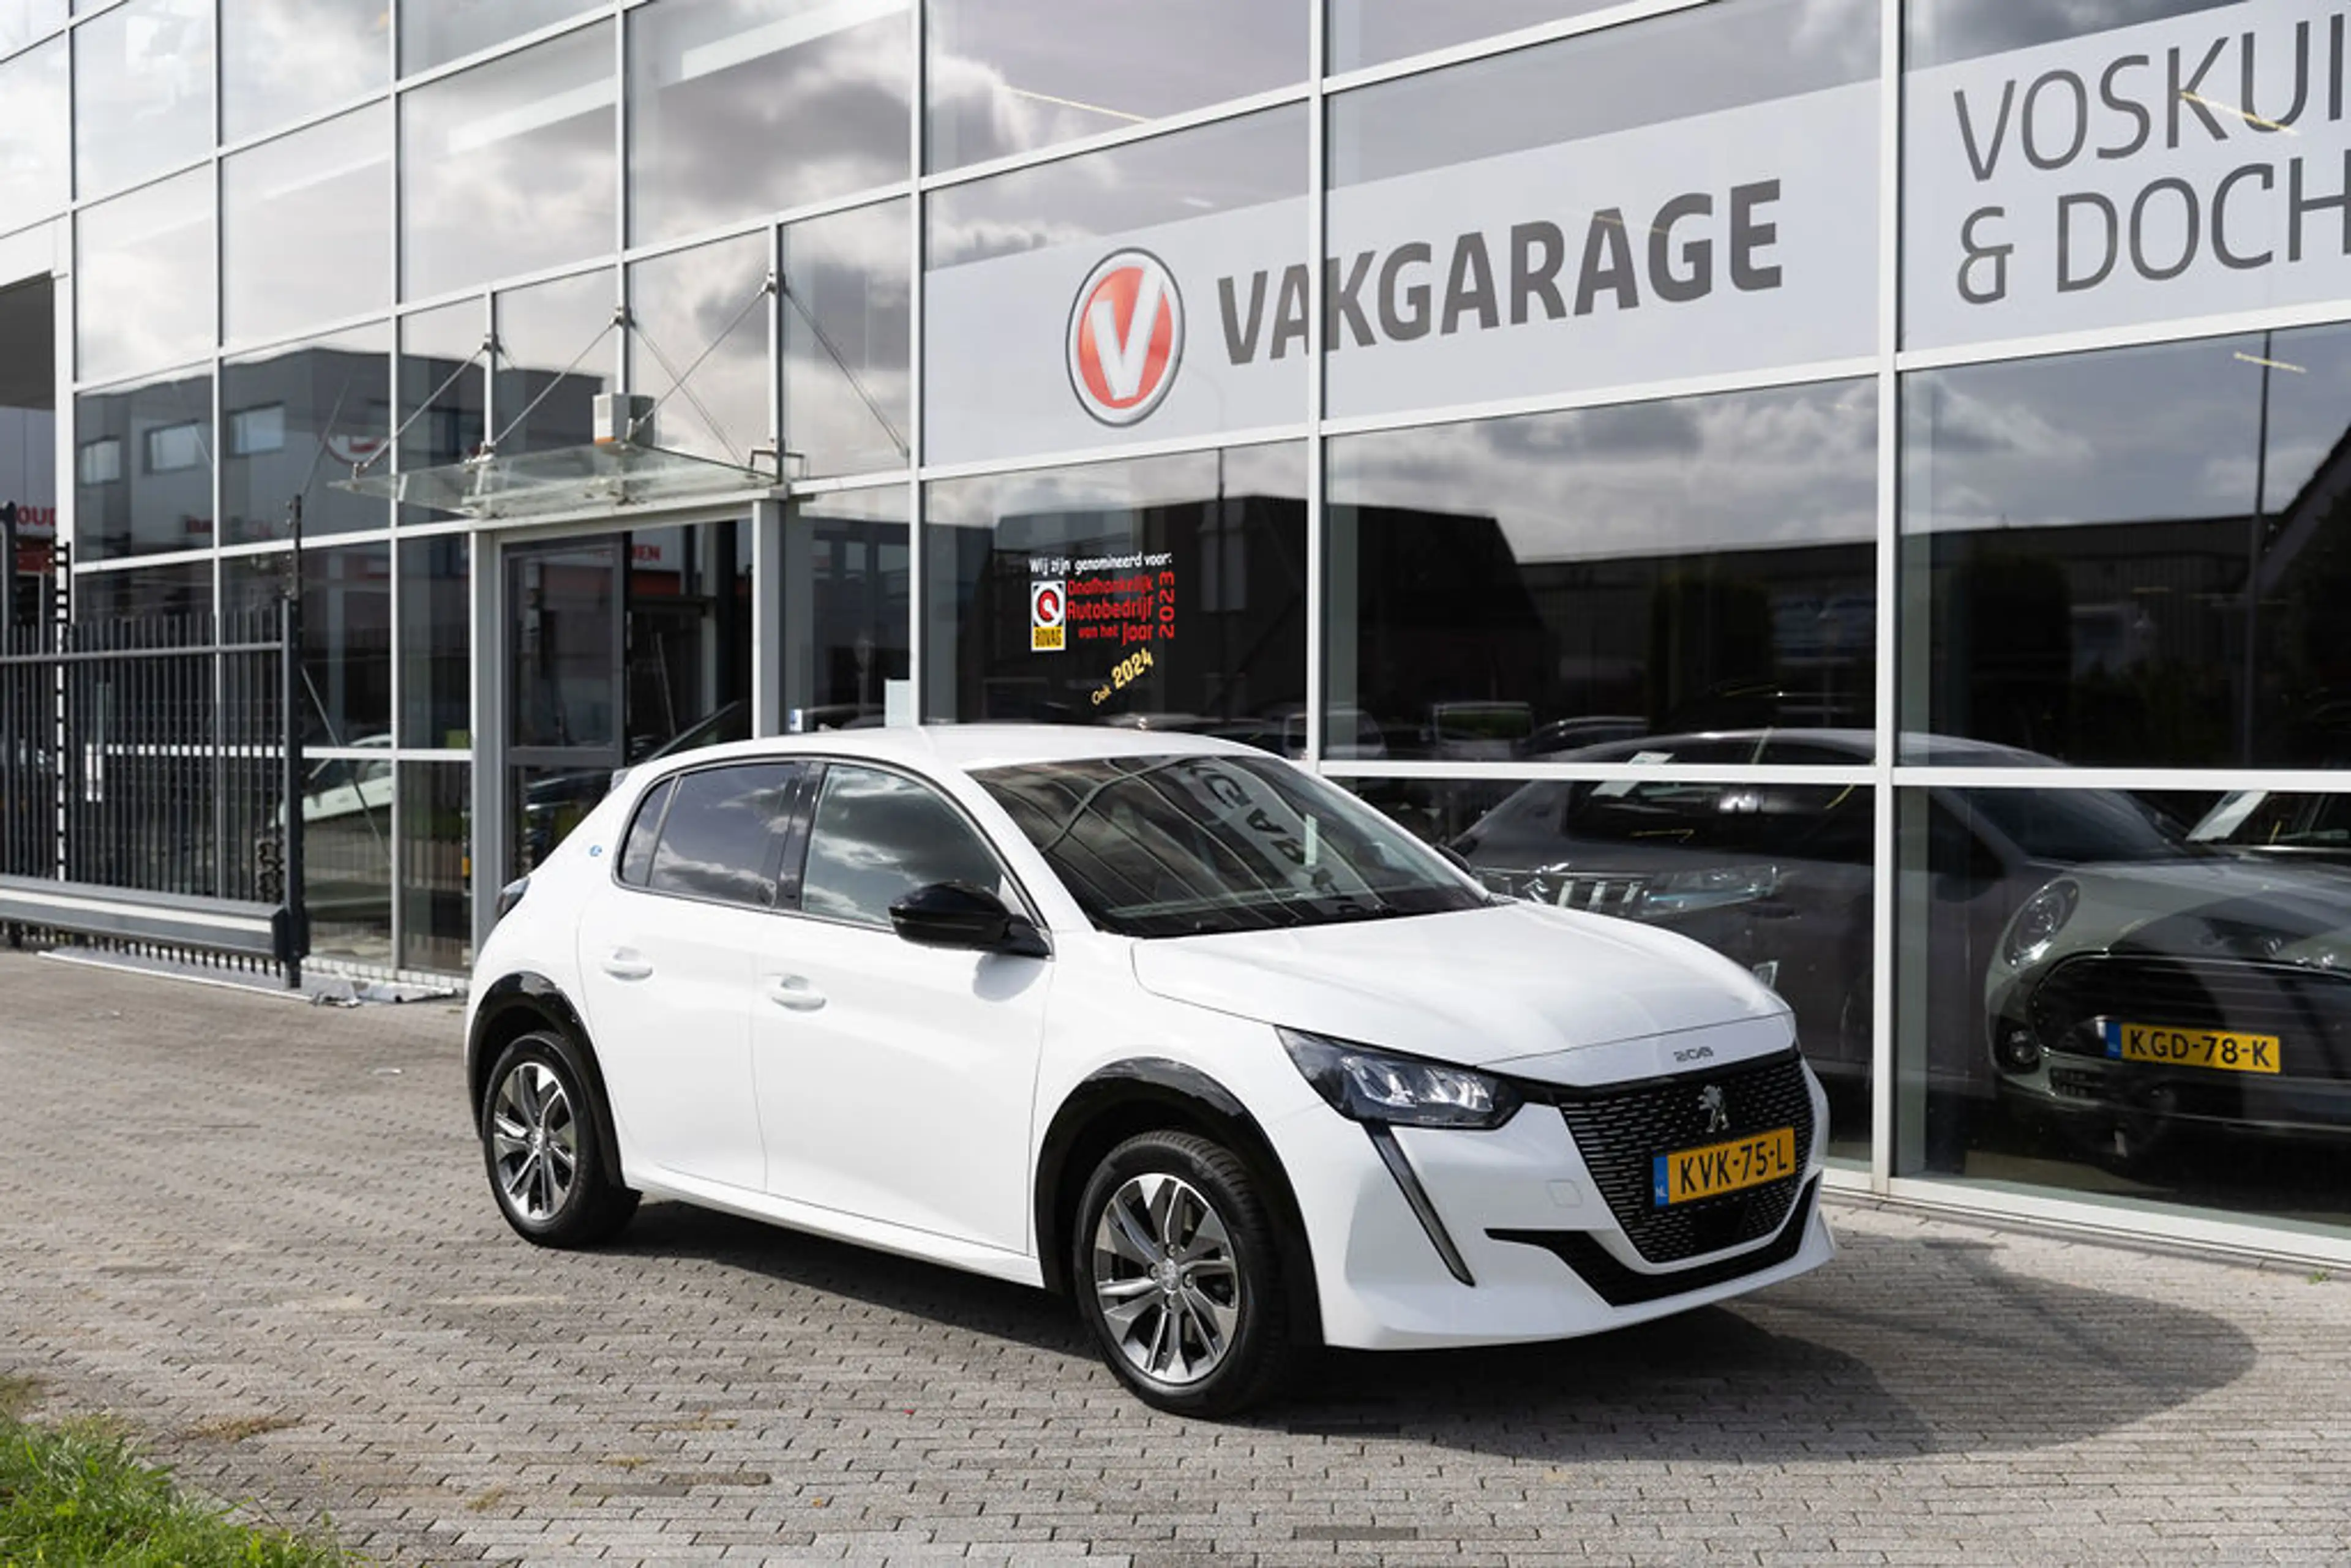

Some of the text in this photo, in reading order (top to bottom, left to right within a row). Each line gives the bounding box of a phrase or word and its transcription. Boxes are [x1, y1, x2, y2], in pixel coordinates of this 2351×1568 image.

[1958, 149, 2351, 305] & DOCH
[1217, 178, 1783, 366] VAKGARAGE
[1029, 552, 1172, 577] Wij zijn genomineerd voor:
[1067, 595, 1153, 621] Autobedrijf
[1158, 571, 1175, 639] 2023
[1078, 626, 1098, 639] van
[1100, 623, 1119, 638] het
[1111, 647, 1154, 689] 2024
[2130, 1030, 2272, 1068] KGD-78-K
[1680, 1138, 1787, 1195] KVK-75-L
